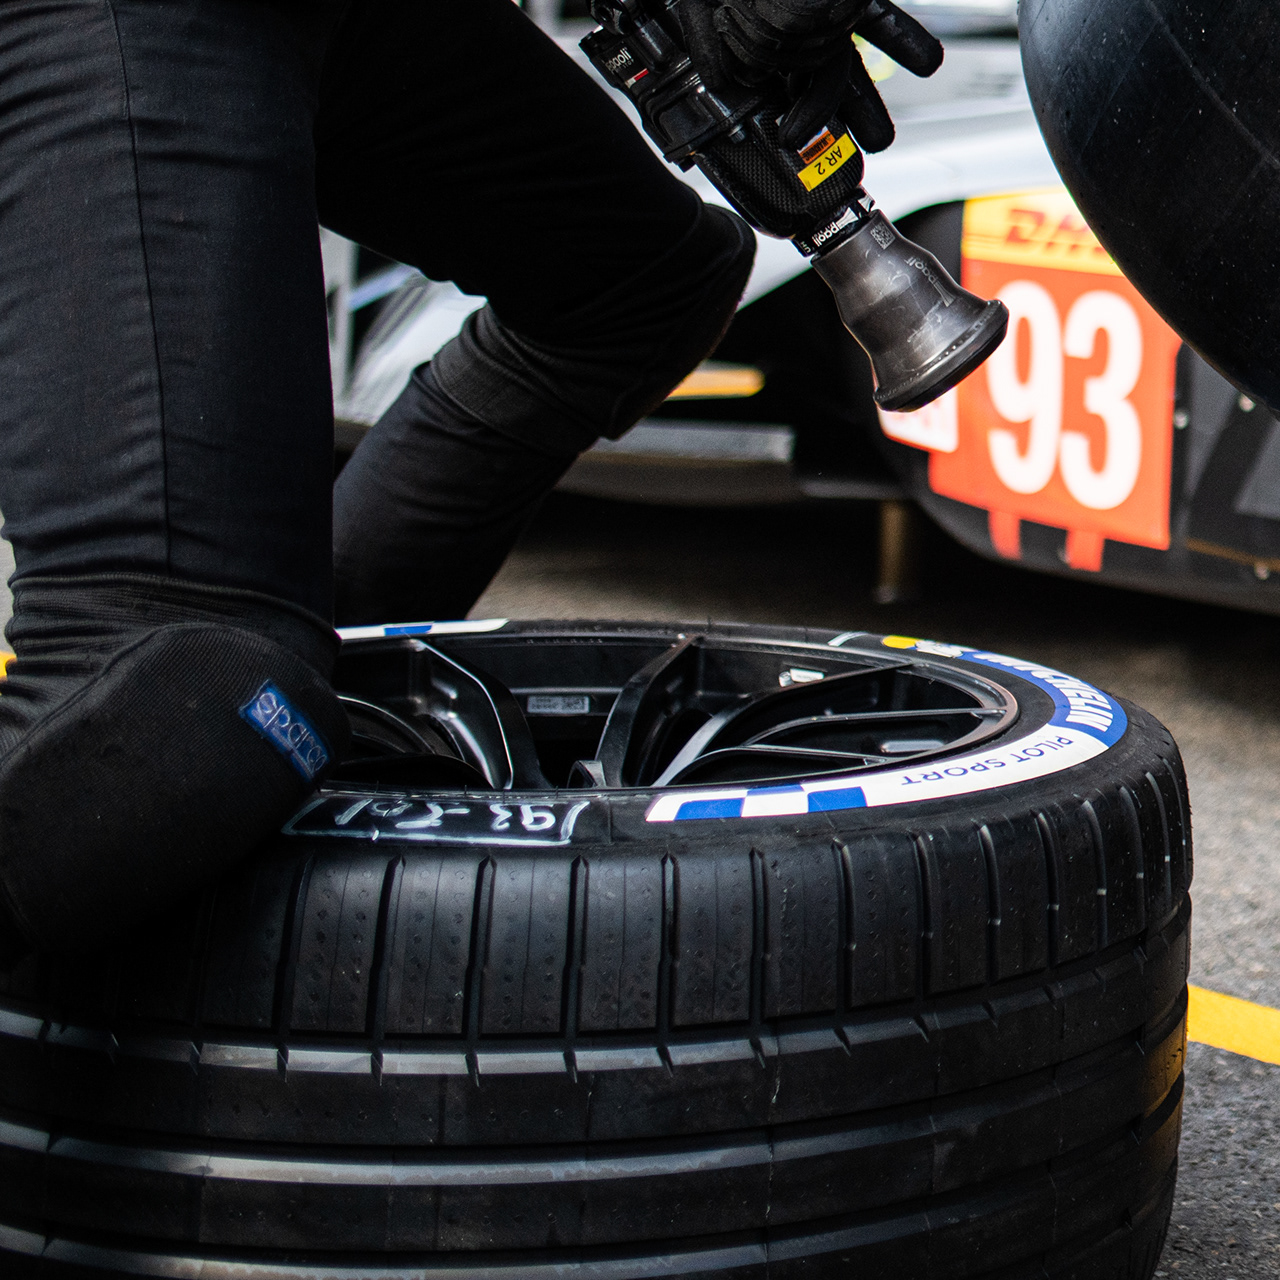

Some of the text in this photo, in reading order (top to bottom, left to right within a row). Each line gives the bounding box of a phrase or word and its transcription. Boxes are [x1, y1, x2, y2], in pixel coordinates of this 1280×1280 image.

[814, 145, 843, 176] AR 2
[811, 222, 840, 247] paoli
[1005, 208, 1107, 253] DH
[986, 280, 1142, 510] 93
[973, 653, 1114, 732] MICHELIN
[252, 692, 327, 776] sparco
[901, 735, 1074, 786] PILOT SPORT
